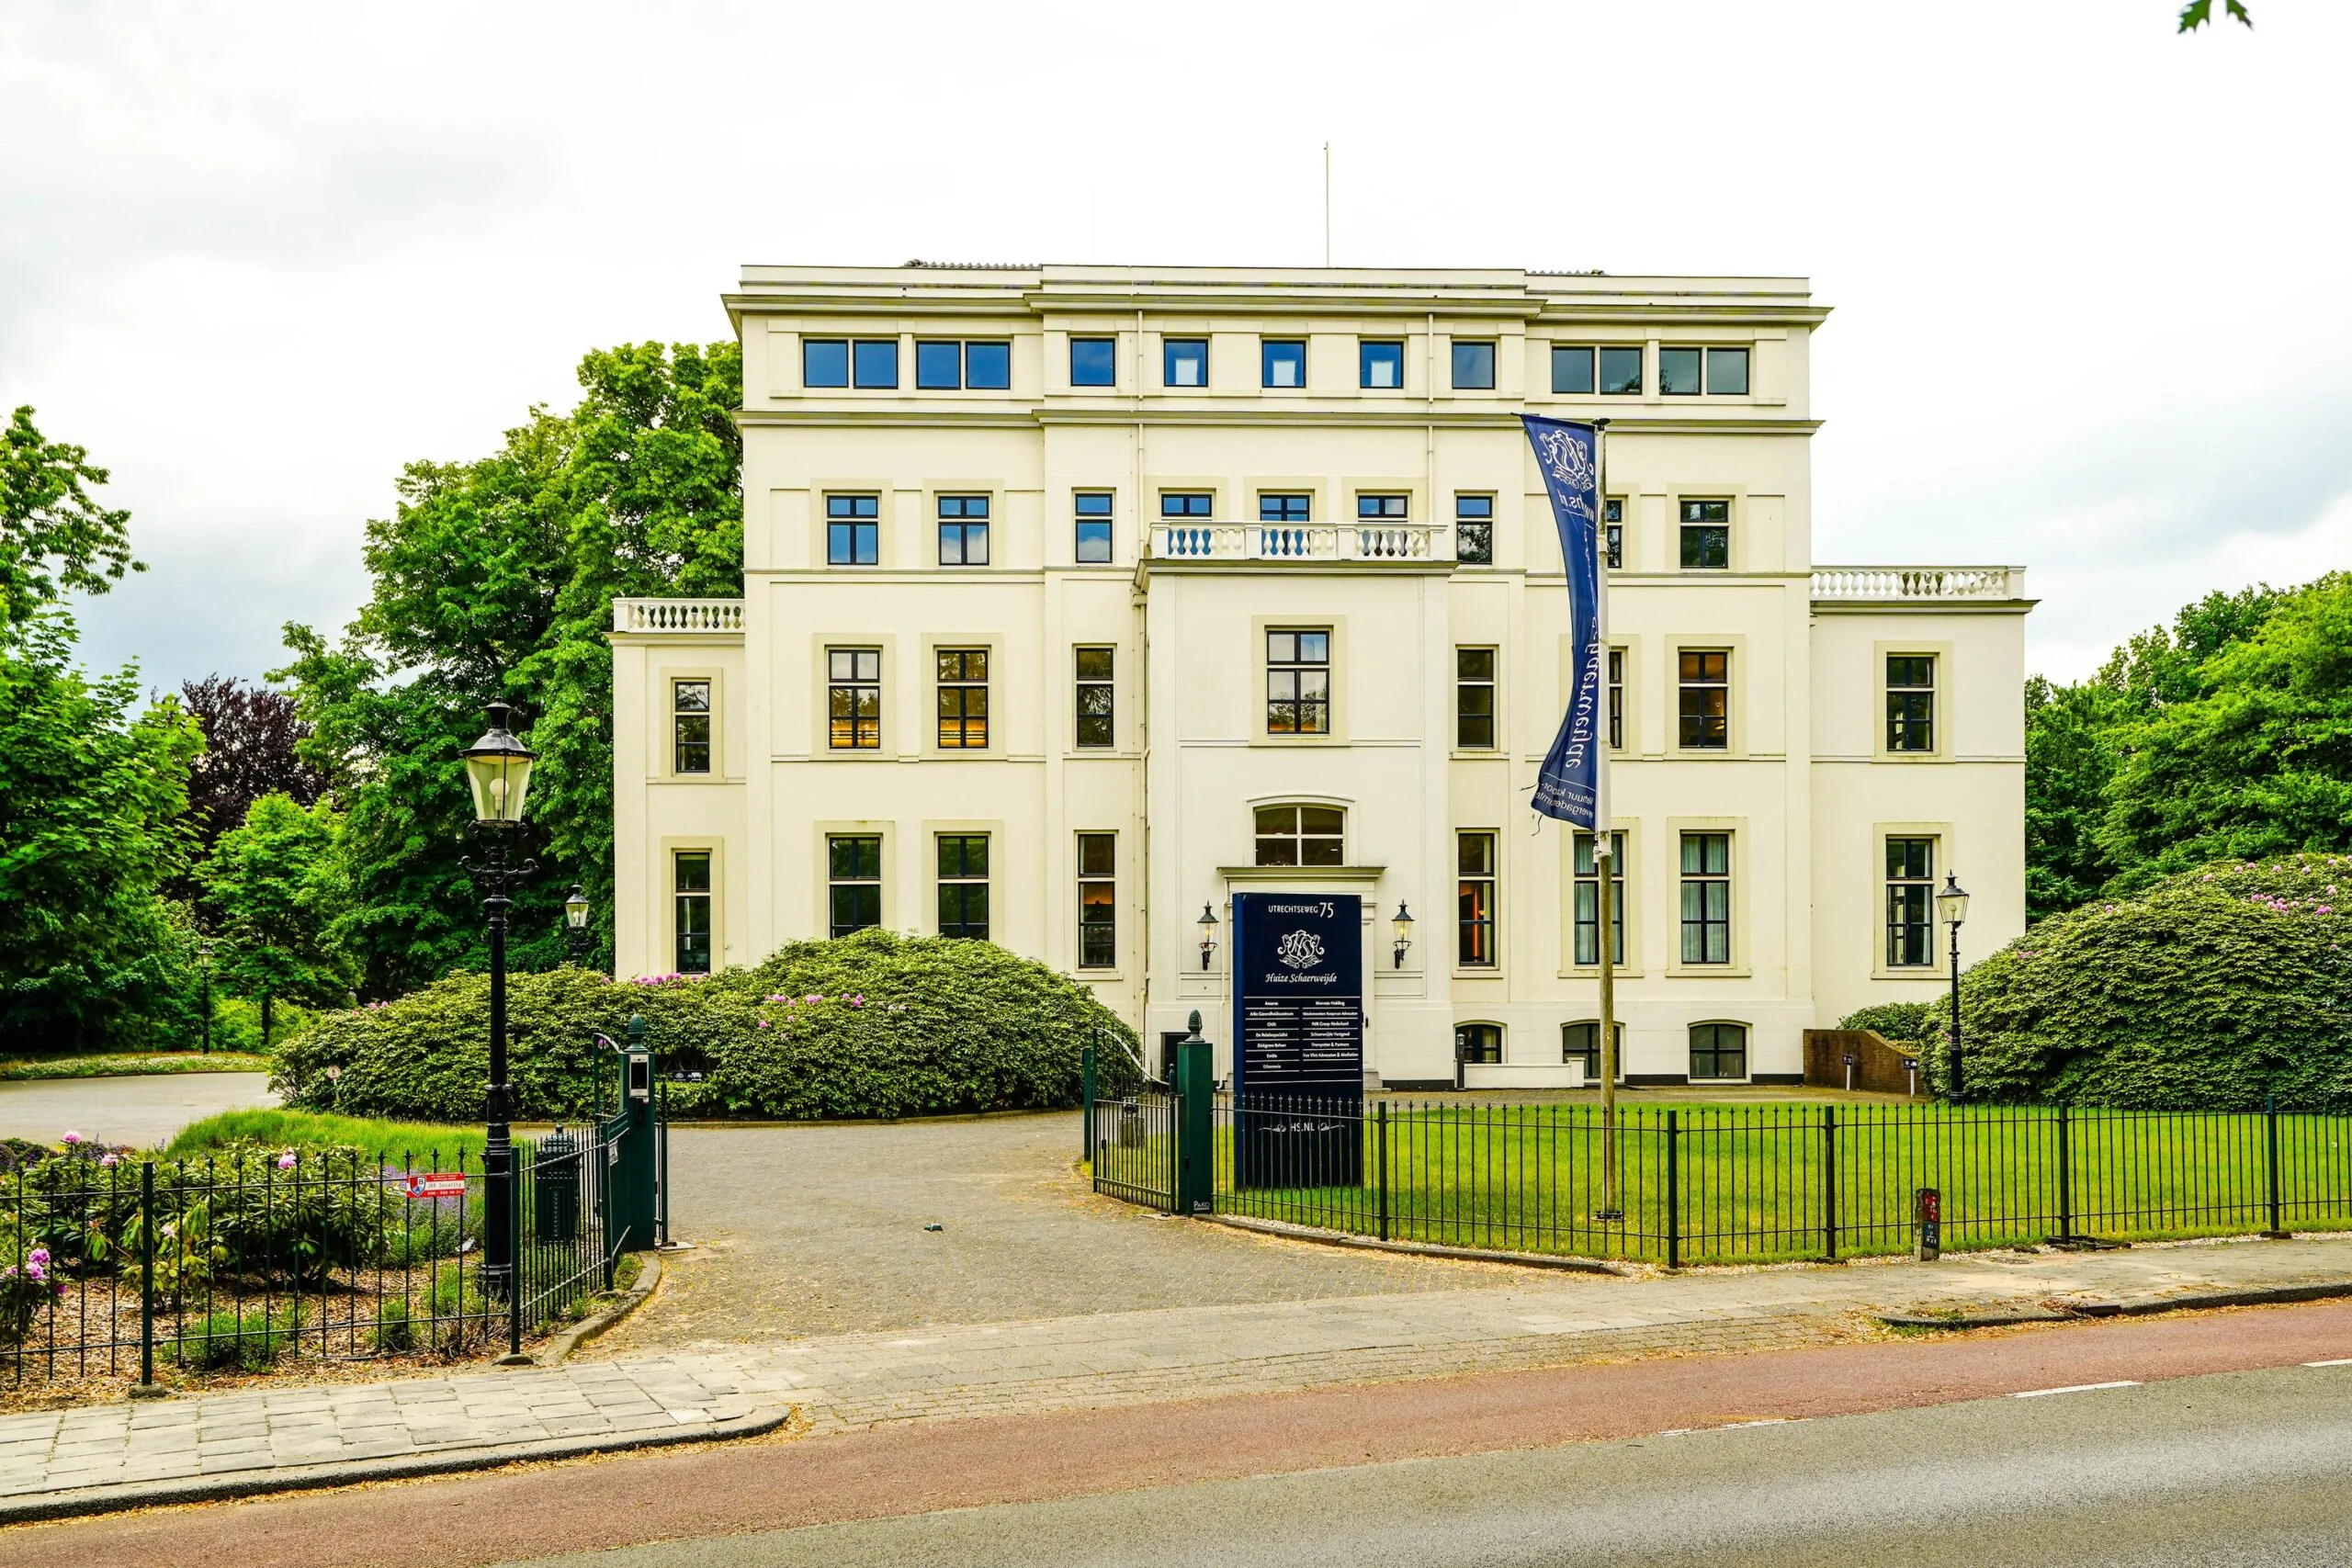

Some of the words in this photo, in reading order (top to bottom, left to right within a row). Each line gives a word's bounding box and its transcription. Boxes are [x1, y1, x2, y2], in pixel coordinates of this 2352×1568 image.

[1268, 905, 1318, 913] UTRECHTSEWEG
[1319, 902, 1334, 918] 75
[1265, 973, 1288, 983] Huize
[1289, 973, 1338, 985] Schaerweijde
[1290, 1122, 1315, 1132] HS.NL
